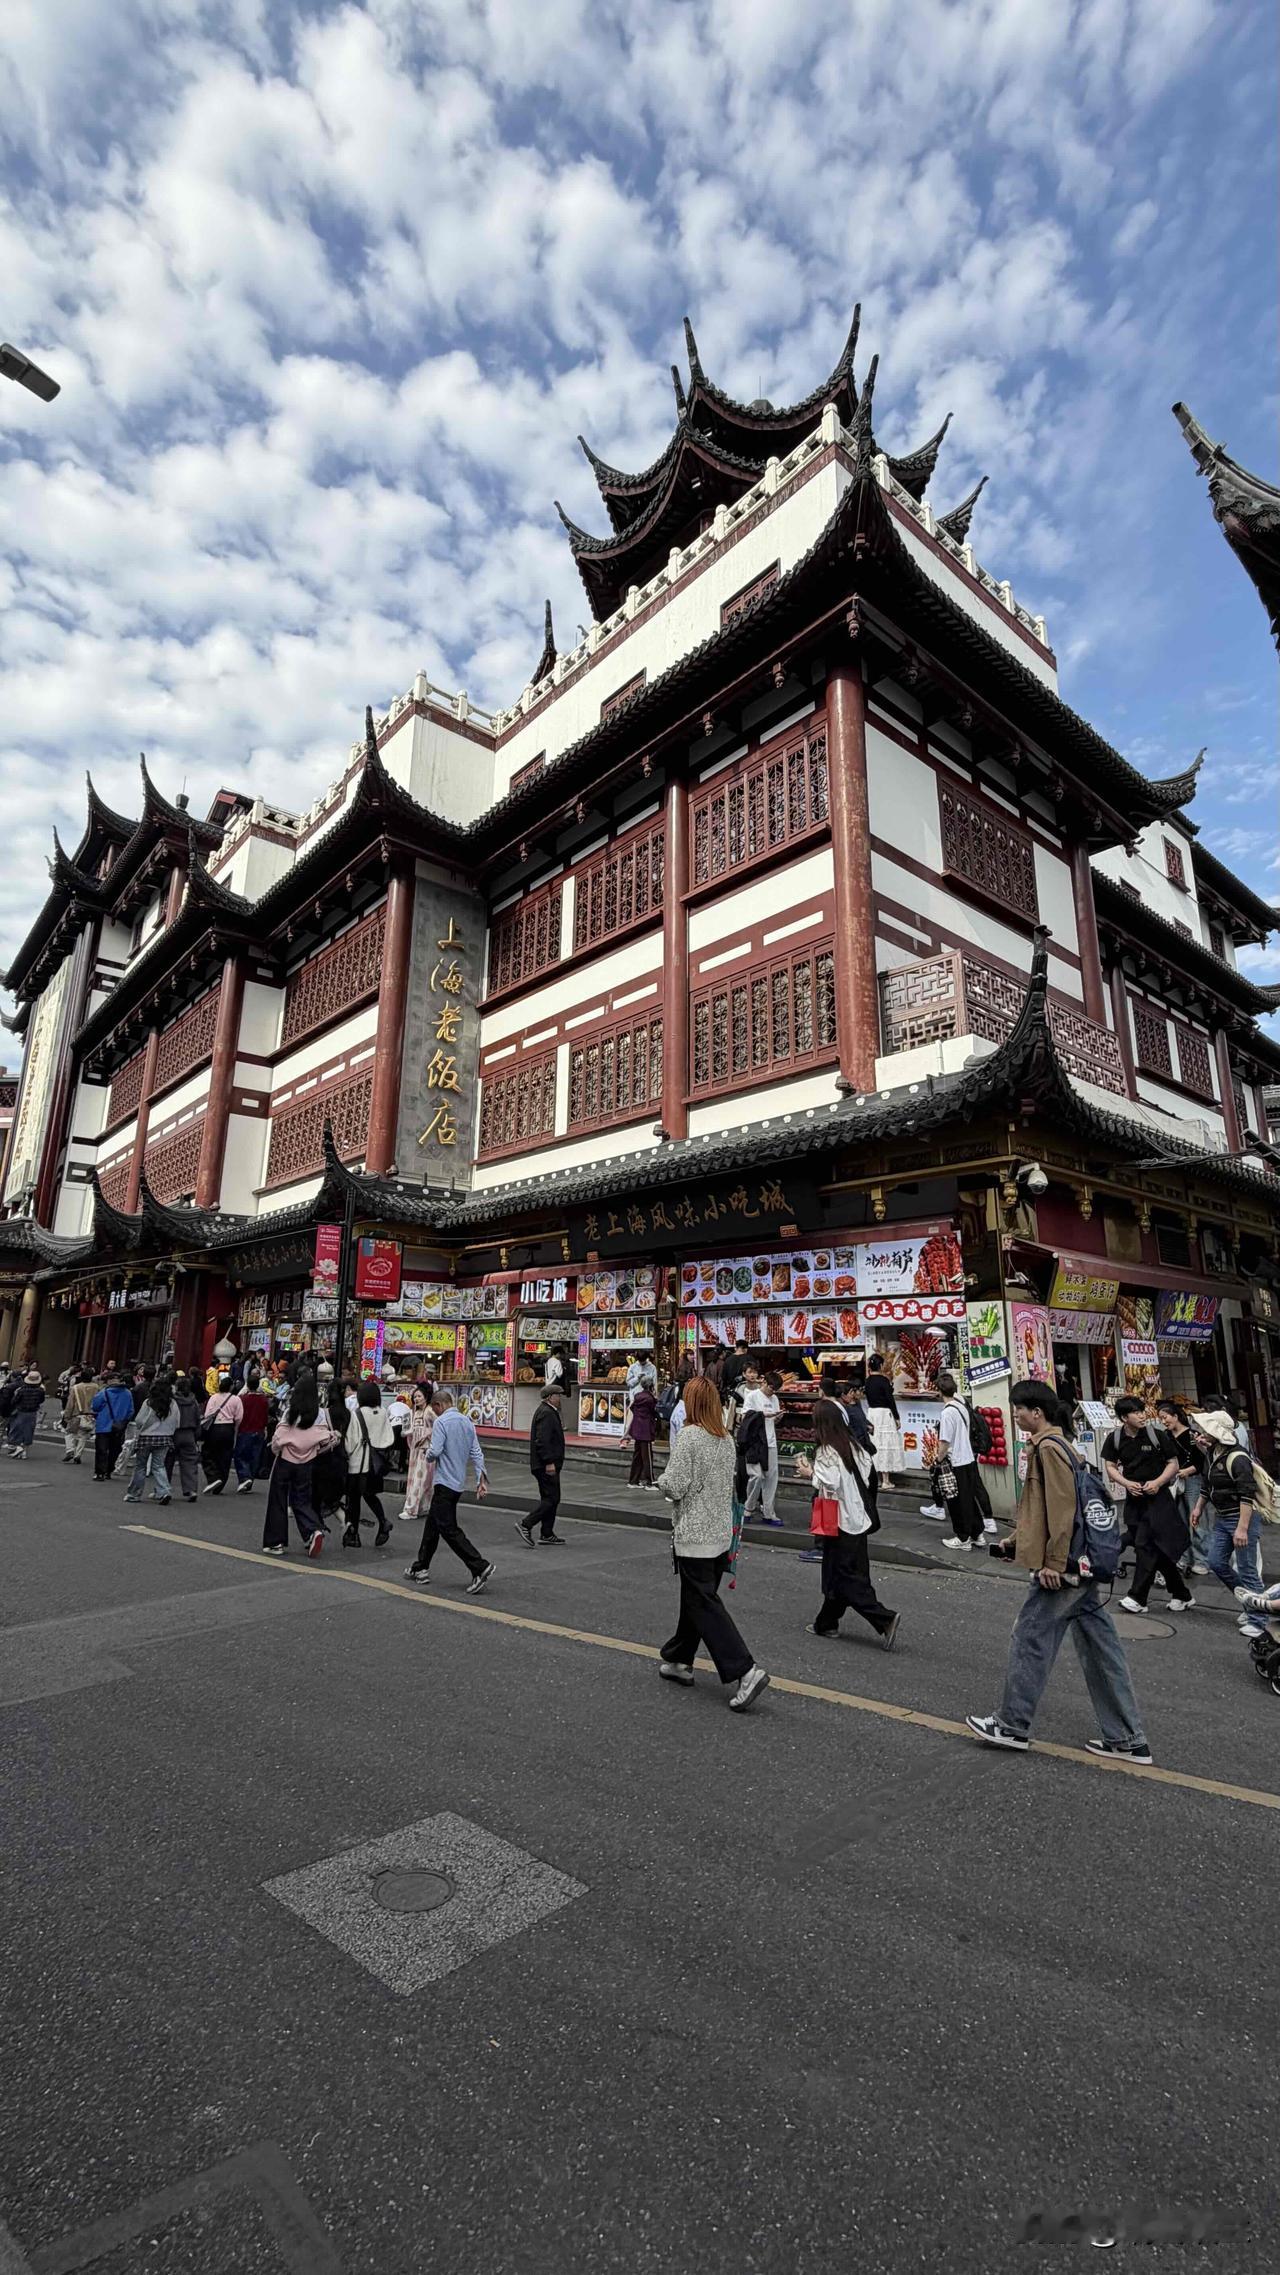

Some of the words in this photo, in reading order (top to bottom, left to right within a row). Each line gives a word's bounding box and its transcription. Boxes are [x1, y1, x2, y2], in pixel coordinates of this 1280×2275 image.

[419, 916, 464, 1145] 上海老饭店
[584, 1179, 795, 1241] 老上海风味小吃城
[520, 1277, 567, 1304] 小吃城
